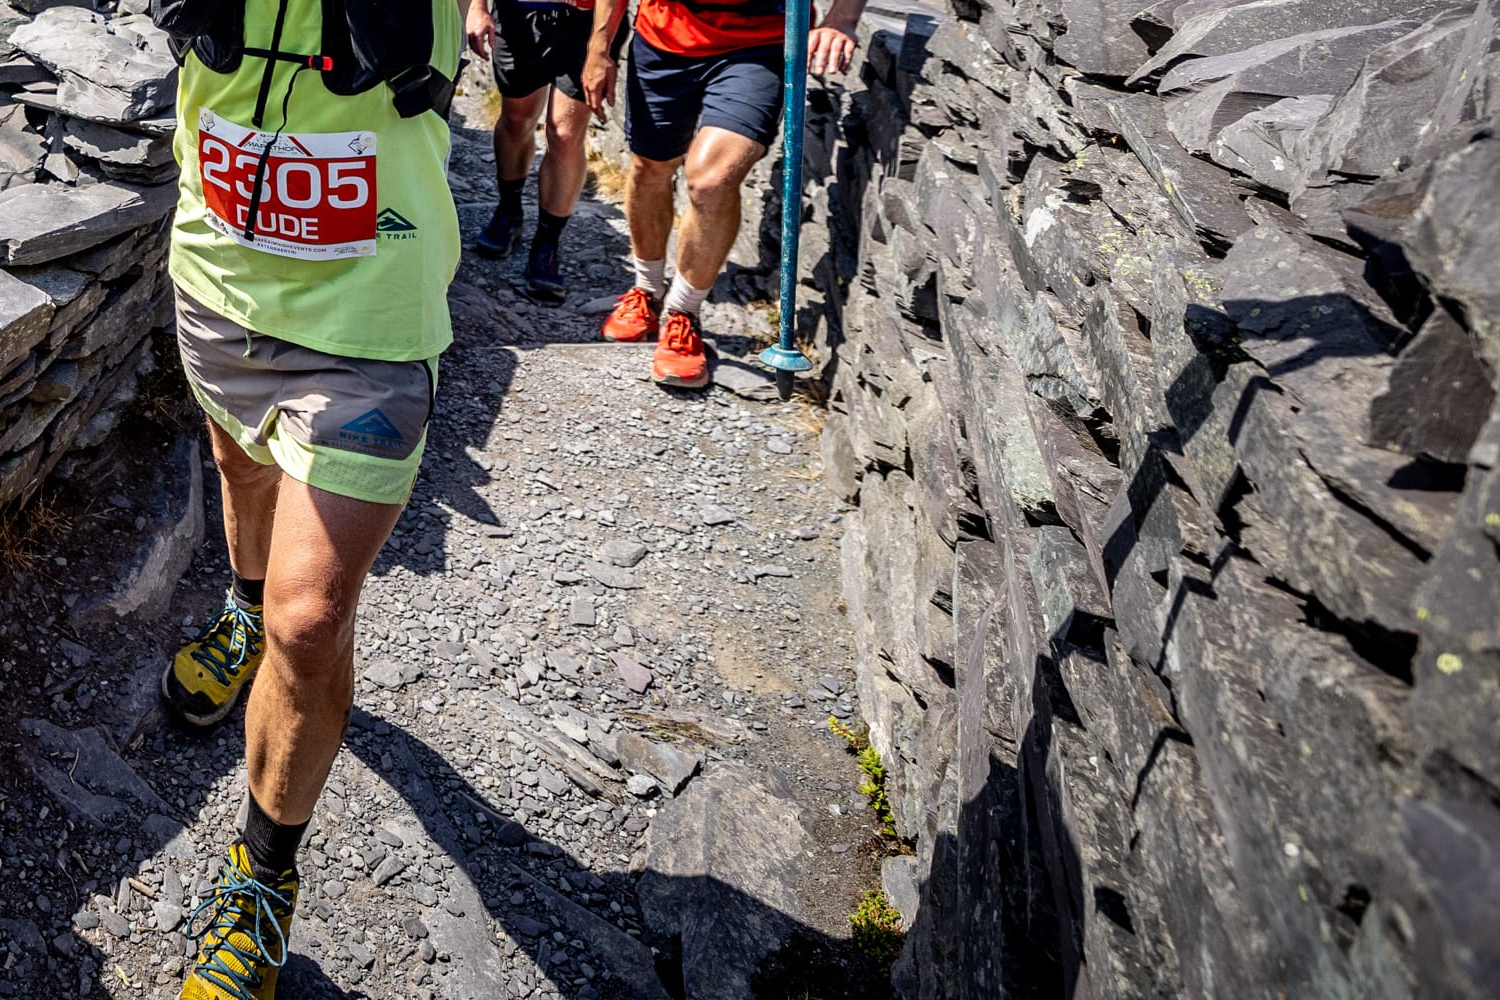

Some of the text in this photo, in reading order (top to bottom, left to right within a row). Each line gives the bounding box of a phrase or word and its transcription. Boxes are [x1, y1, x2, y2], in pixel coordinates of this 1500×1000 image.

[203, 138, 370, 209] 2305
[236, 204, 319, 240] DUDE
[387, 232, 417, 240] TRAIL
[340, 431, 368, 443] NIKE
